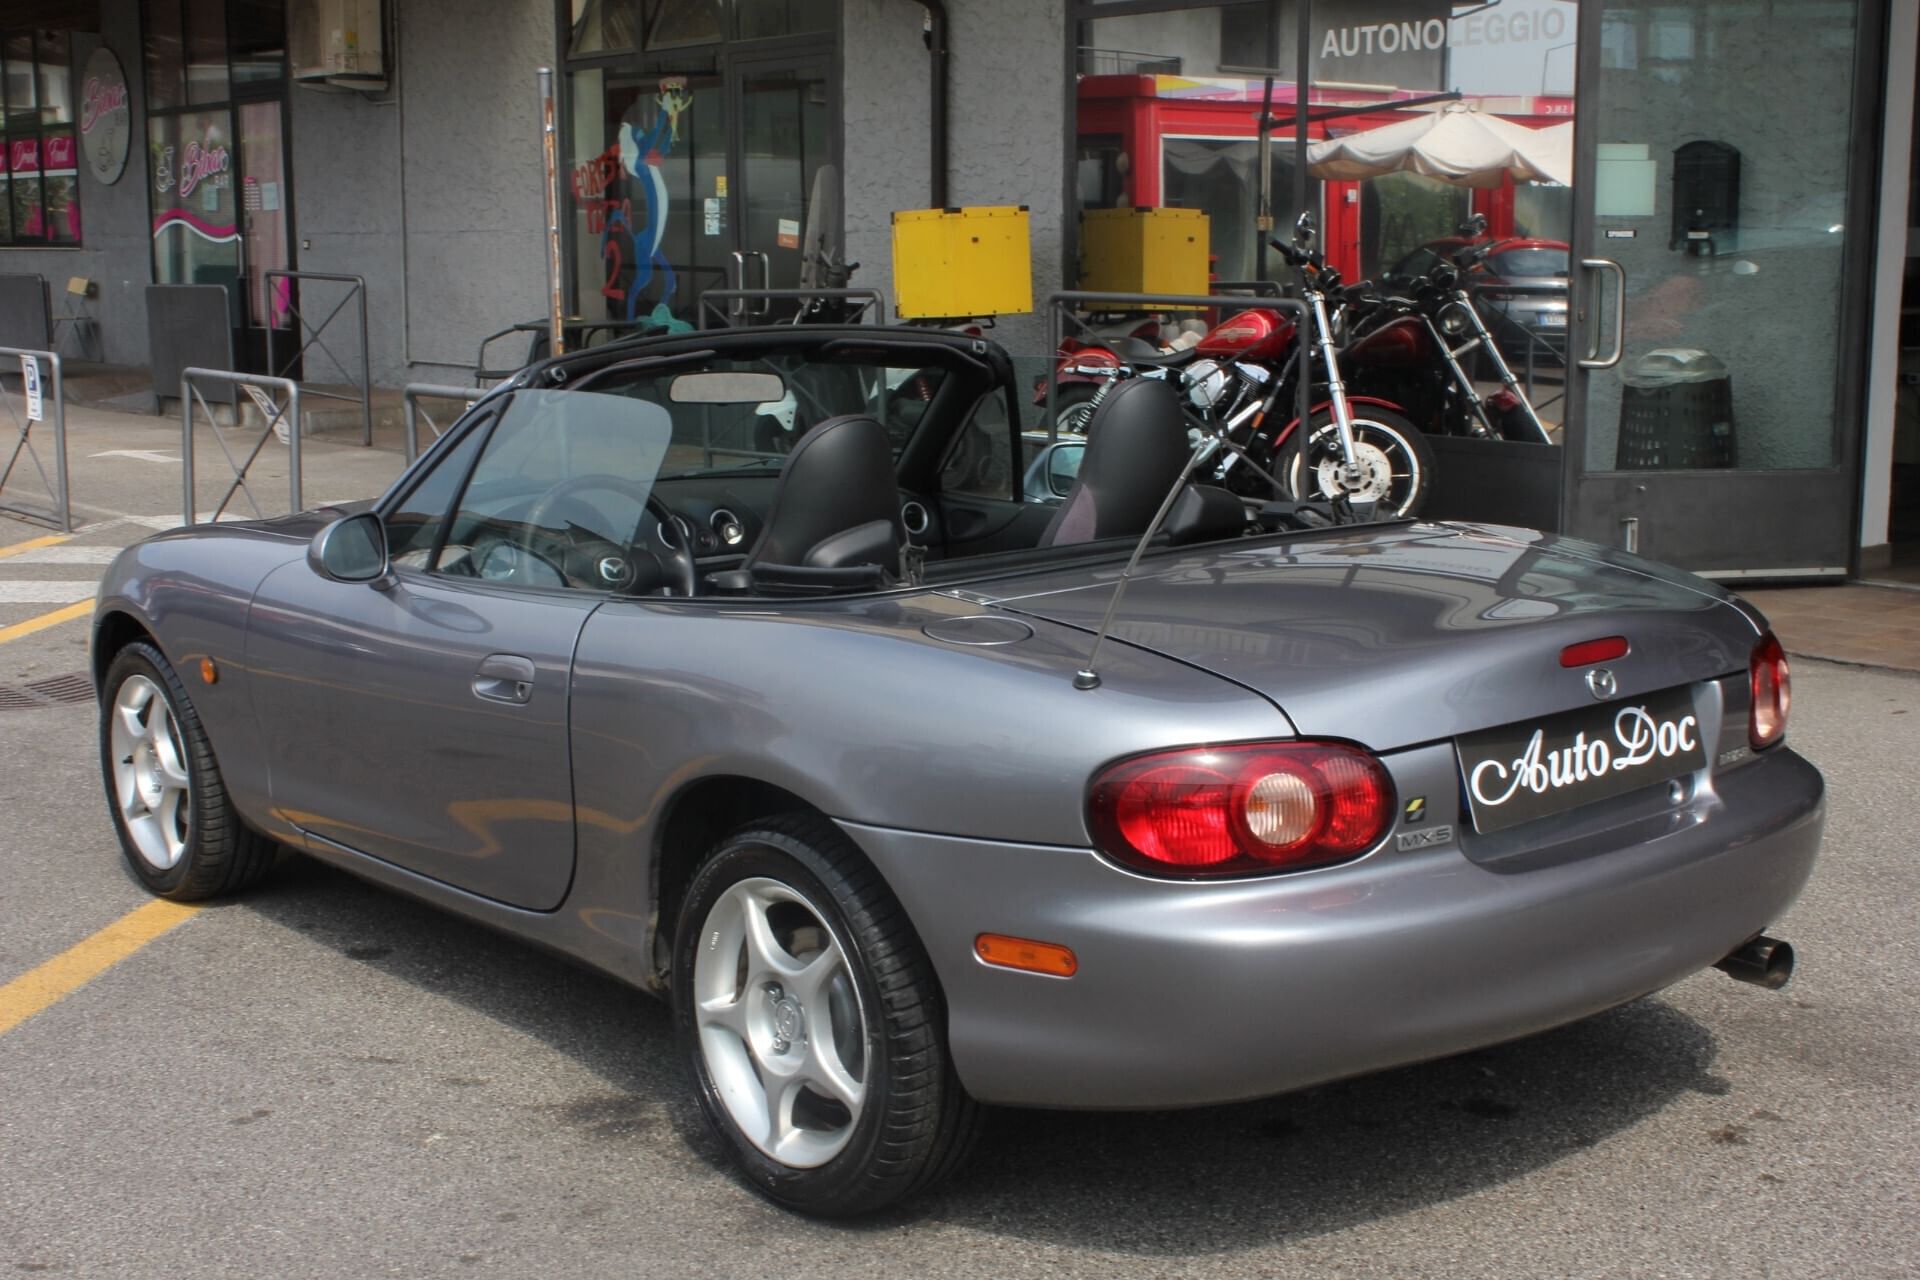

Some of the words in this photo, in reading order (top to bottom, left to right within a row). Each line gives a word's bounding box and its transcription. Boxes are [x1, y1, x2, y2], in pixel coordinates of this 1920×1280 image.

[1320, 8, 1566, 58] AUTONOLEGGIO
[601, 239, 625, 300] 2
[1471, 728, 1610, 805] Auto
[1612, 705, 1696, 771] Doc
